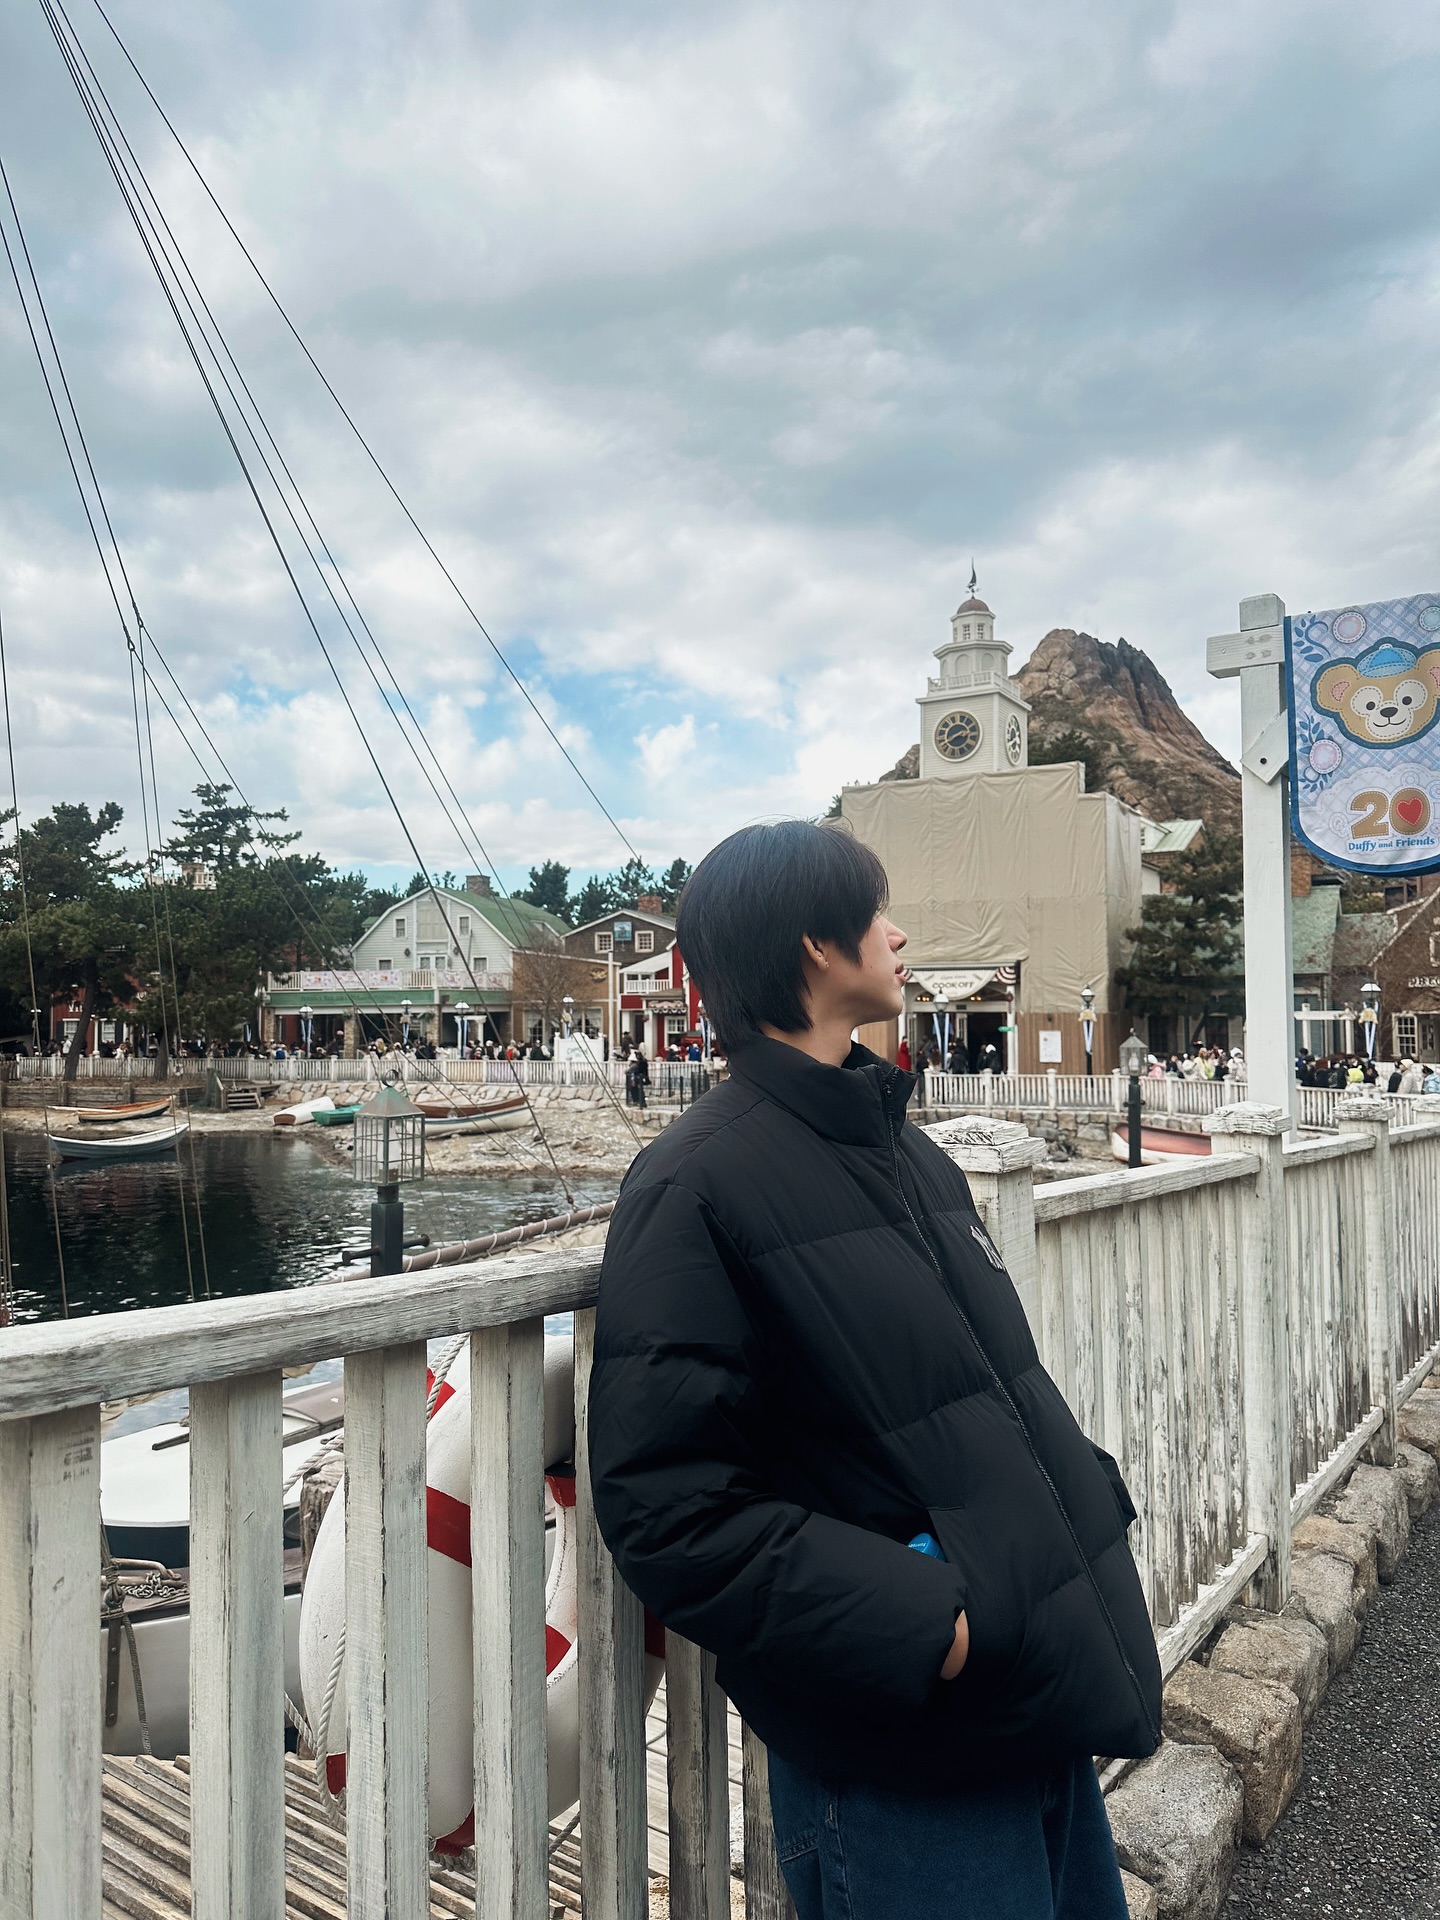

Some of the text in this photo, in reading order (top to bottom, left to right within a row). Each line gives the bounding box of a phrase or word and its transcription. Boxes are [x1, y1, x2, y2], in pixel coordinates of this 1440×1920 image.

[1350, 787, 1431, 839] 20
[1348, 840, 1377, 852] Duffy
[1395, 836, 1435, 847] Friends
